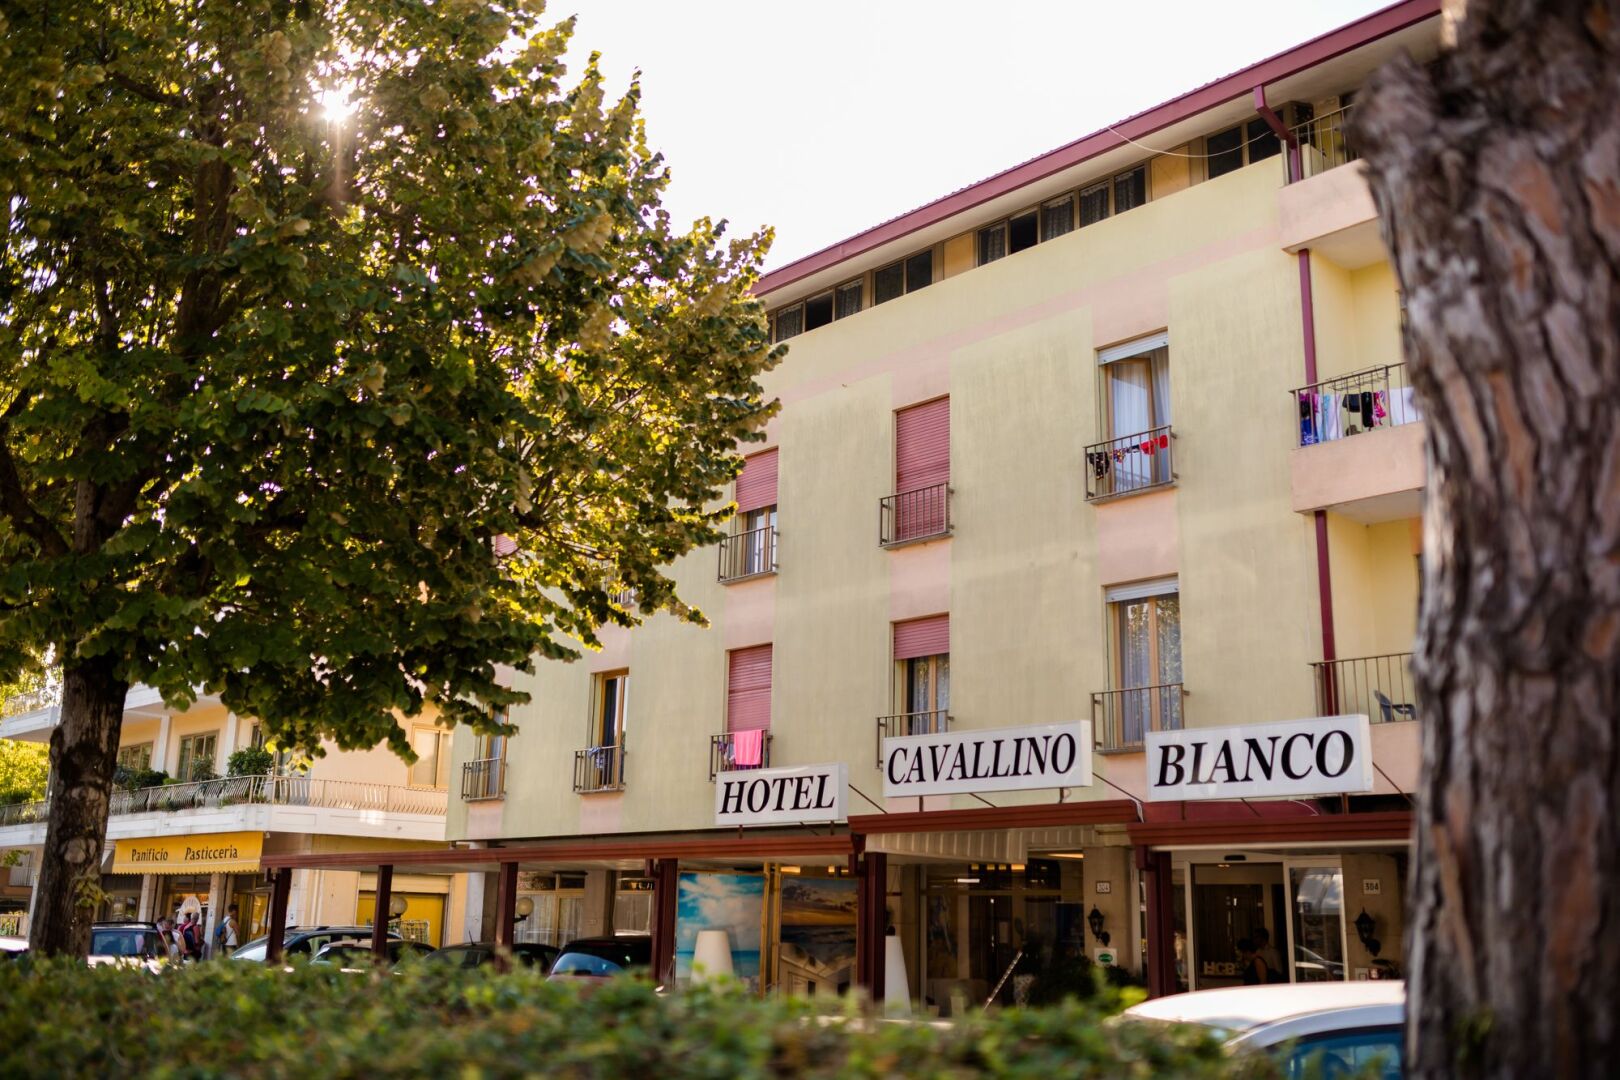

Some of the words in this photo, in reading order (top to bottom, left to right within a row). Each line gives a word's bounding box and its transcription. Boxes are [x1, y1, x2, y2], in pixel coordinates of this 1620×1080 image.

[887, 733, 1077, 785] CAVALLINO
[1154, 730, 1354, 787] BIANCO
[719, 774, 836, 814] HOTEL
[131, 848, 169, 862] Panificio
[184, 845, 238, 861] Pasticceria
